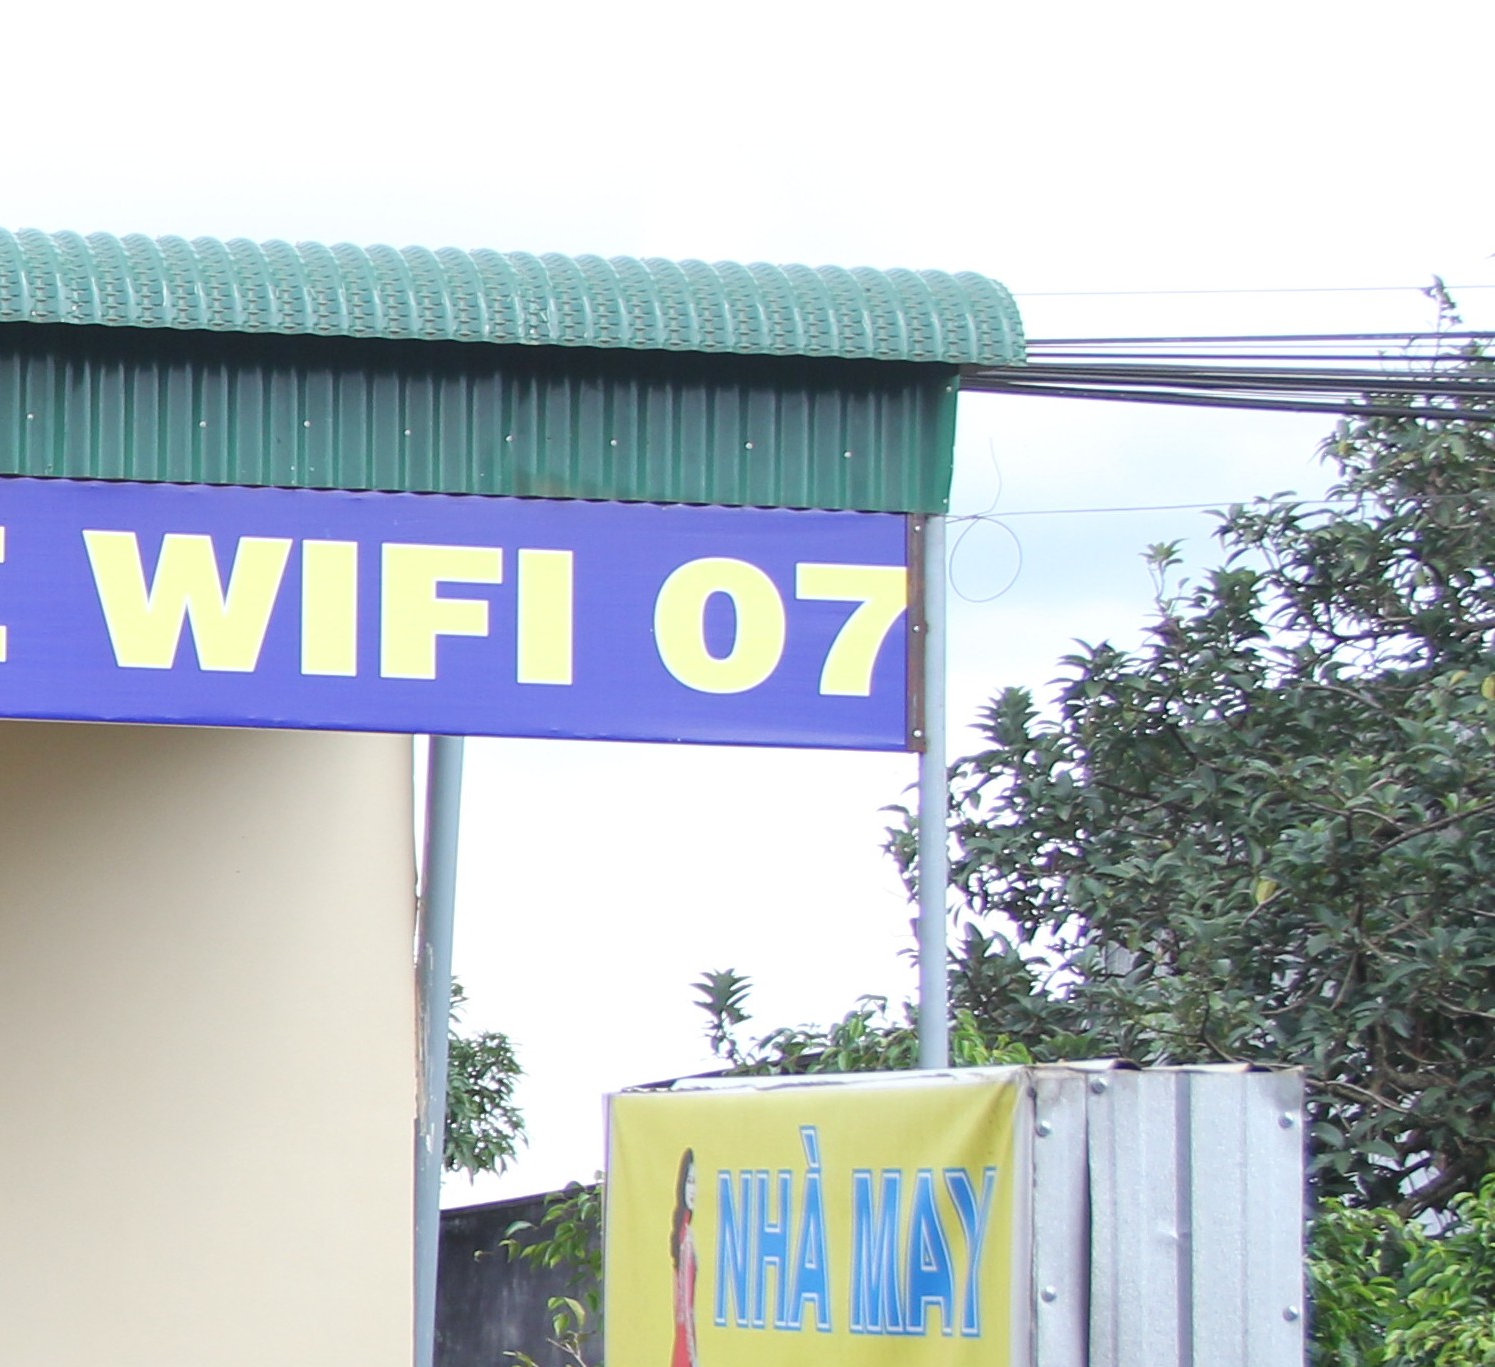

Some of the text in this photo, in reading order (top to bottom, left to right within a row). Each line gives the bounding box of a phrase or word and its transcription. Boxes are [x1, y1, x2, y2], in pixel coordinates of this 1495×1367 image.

[82, 529, 574, 685] WIFI
[653, 556, 907, 697] 07
[714, 1125, 998, 1338] NHÀ MAY
